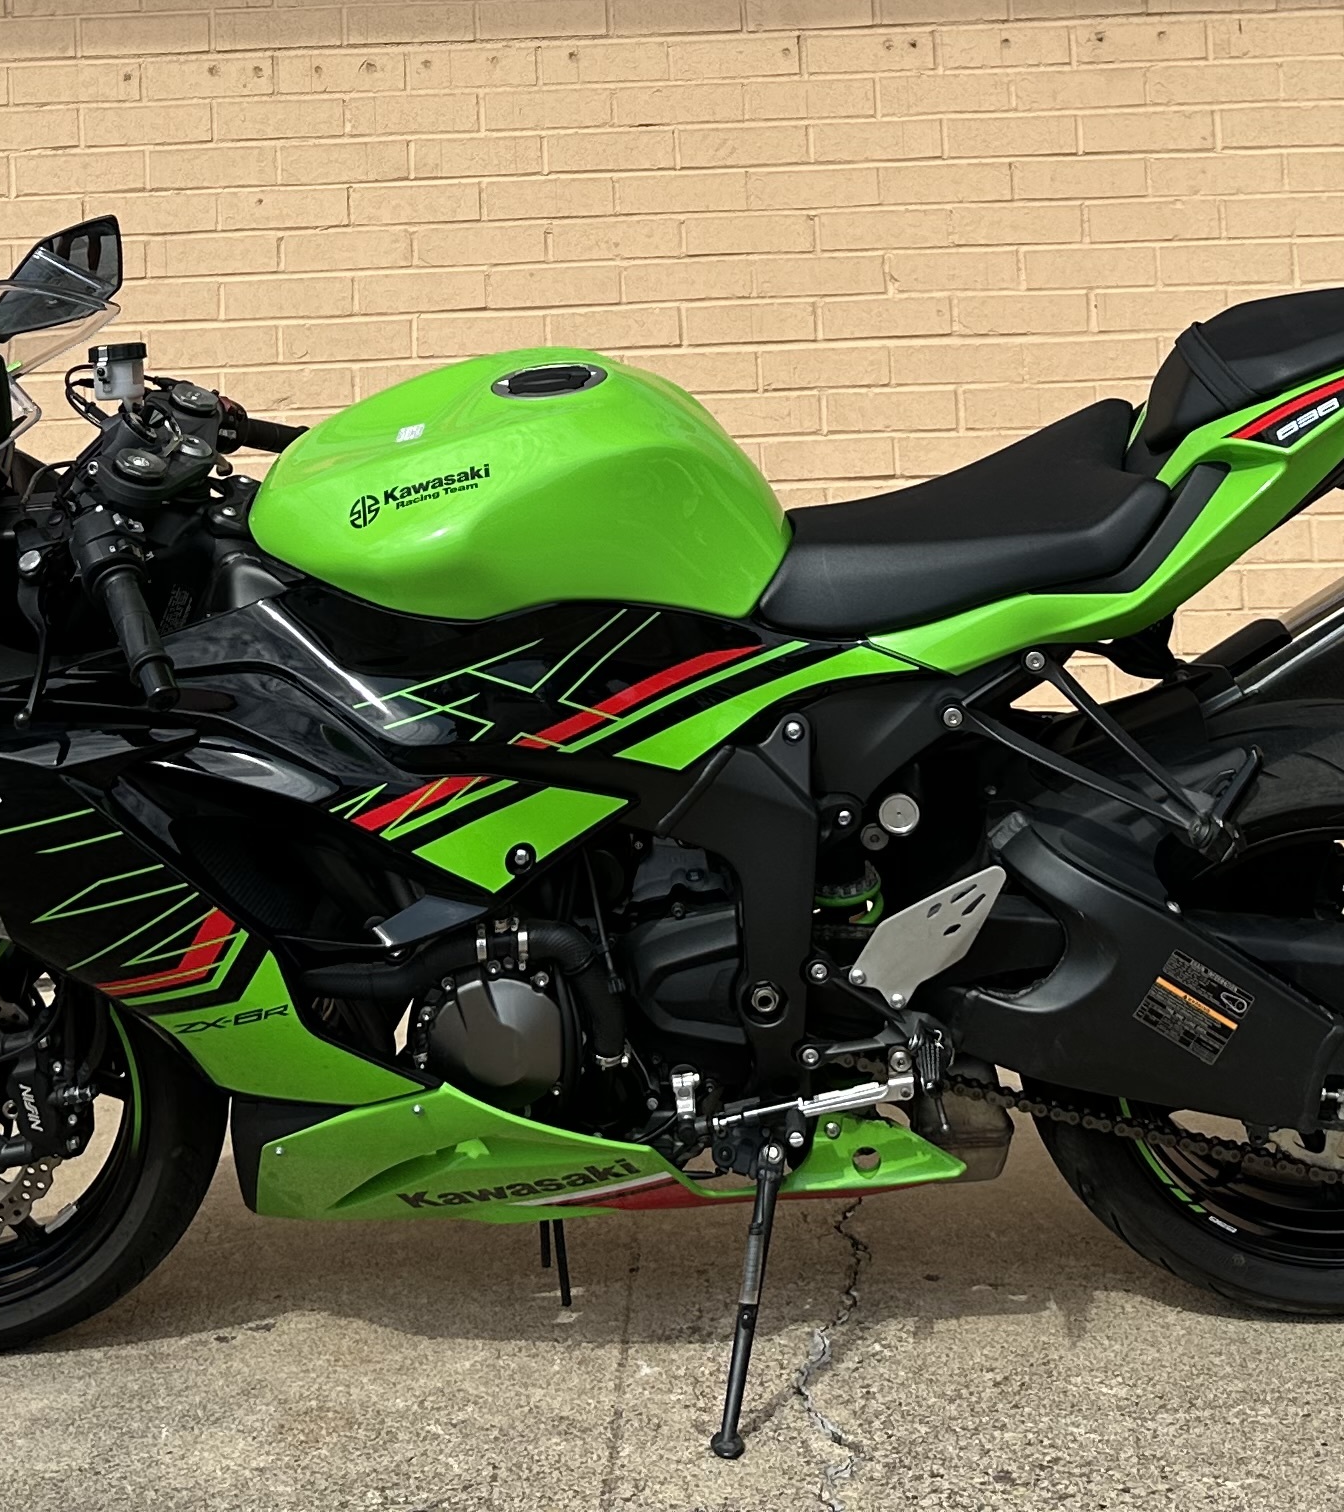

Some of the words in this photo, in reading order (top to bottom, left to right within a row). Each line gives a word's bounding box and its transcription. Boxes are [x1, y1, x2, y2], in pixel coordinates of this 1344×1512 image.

[383, 463, 491, 505] Kawasaki
[395, 491, 440, 510] Racing
[442, 482, 479, 495] Team
[174, 1004, 289, 1034] ZX-6R
[396, 1158, 641, 1208] Kawasaki
